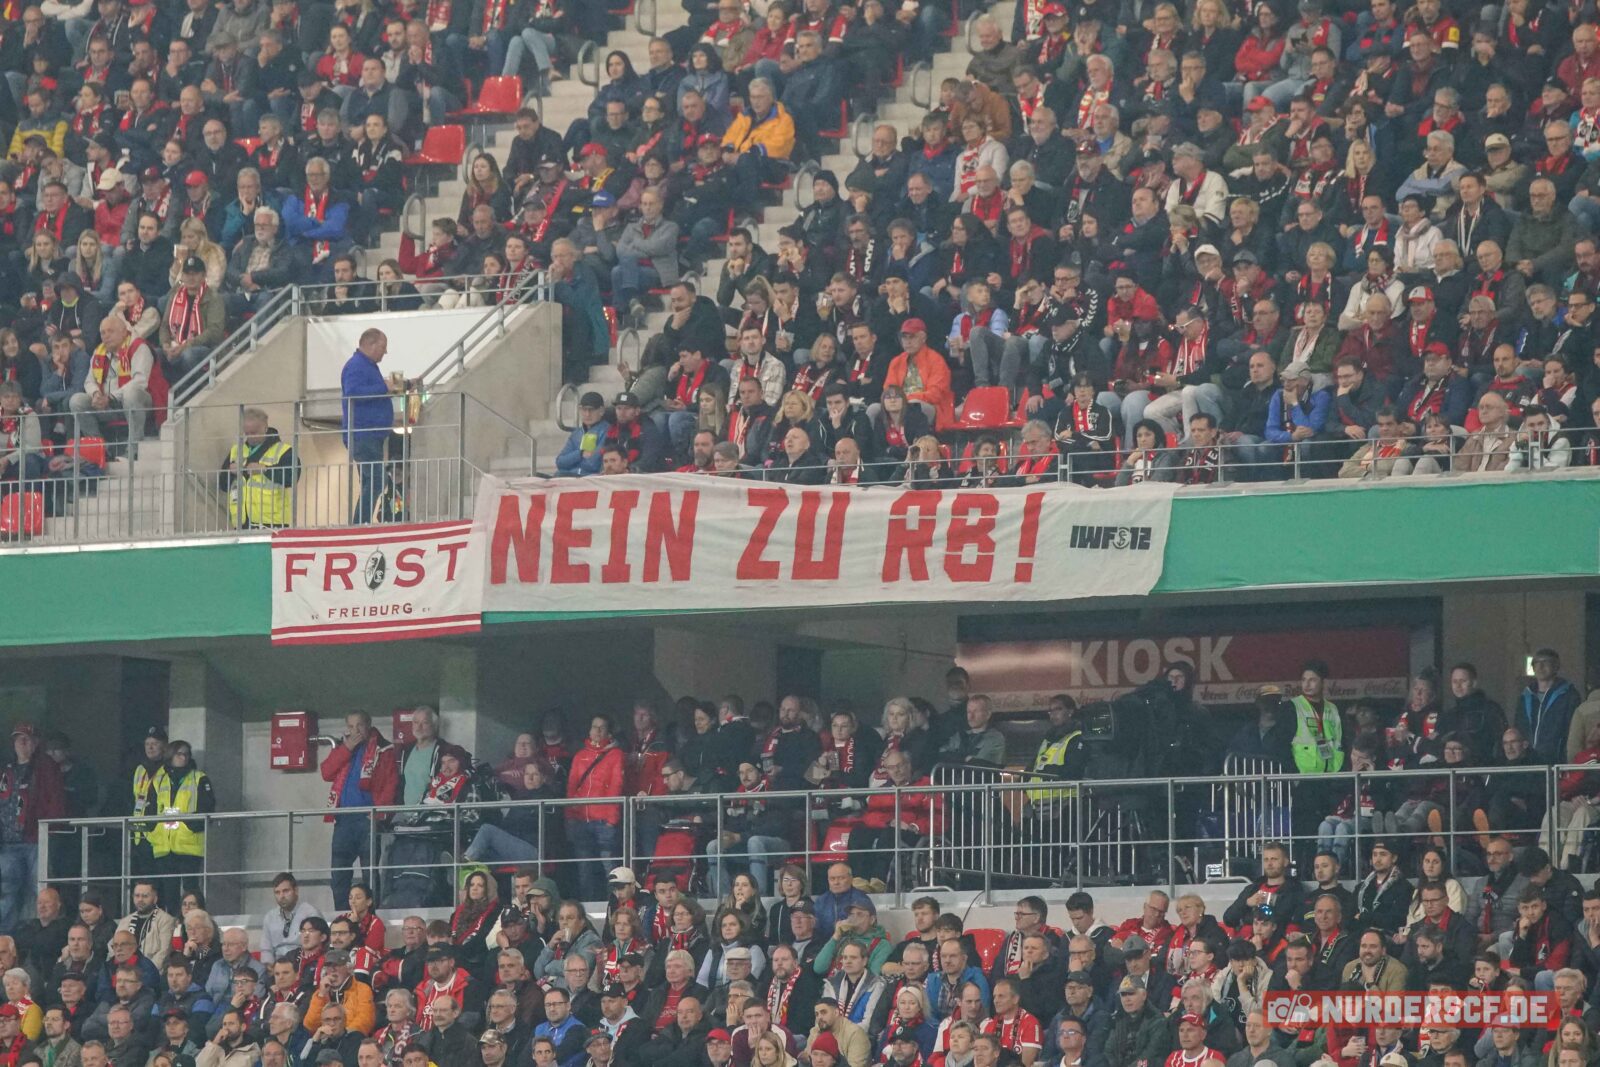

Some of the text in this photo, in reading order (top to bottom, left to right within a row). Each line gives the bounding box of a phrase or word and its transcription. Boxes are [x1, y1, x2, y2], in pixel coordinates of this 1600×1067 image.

[490, 488, 1046, 584] NEIN ZU RB!
[329, 603, 413, 619] FREIBURG
[1070, 637, 1234, 686] KIOSK
